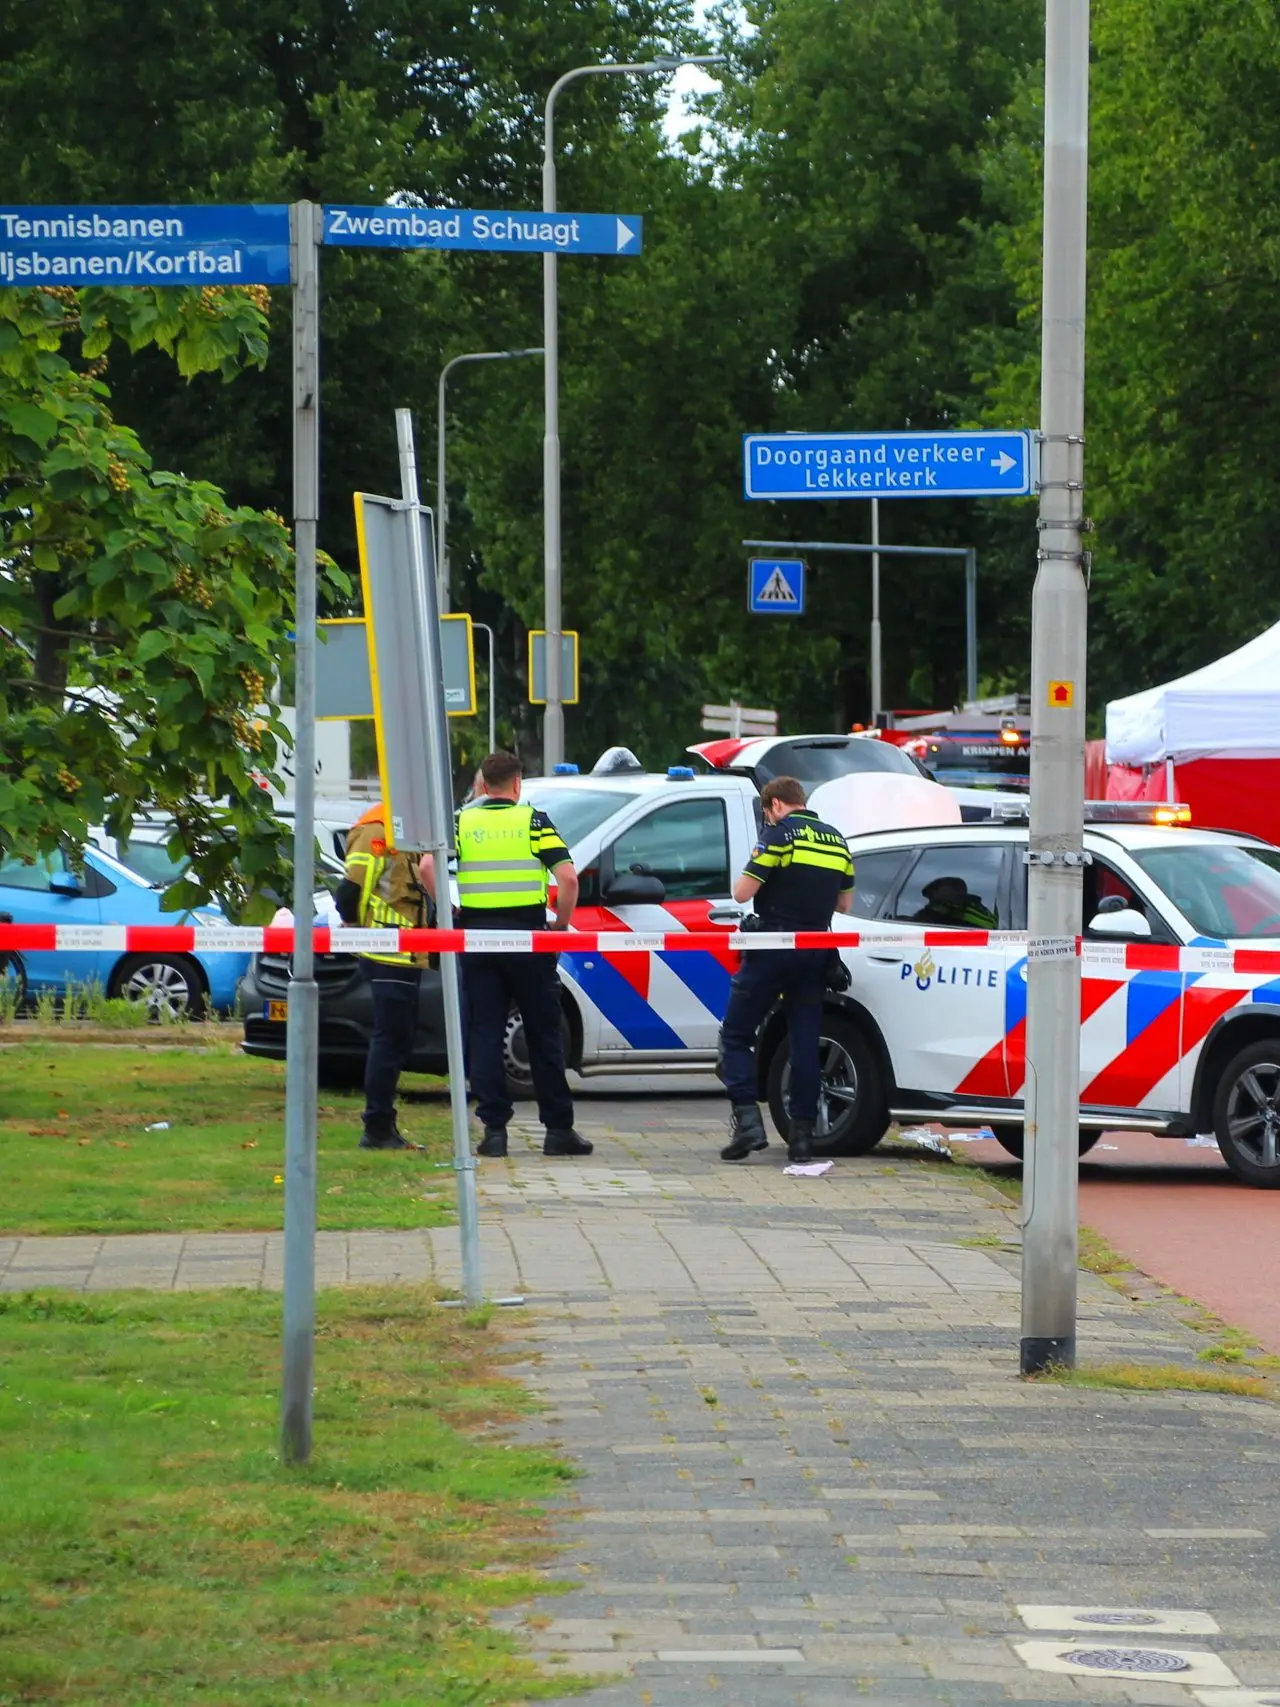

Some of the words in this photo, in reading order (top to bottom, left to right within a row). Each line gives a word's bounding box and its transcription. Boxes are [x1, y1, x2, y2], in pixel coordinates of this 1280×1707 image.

[1, 213, 184, 238] Tennisbanen
[328, 210, 460, 239] Zwembad
[472, 215, 580, 246] Schuagt
[756, 444, 886, 470] Doorgaand
[893, 443, 985, 464] verkeer
[805, 467, 938, 488] Lekkerkerk
[962, 745, 1015, 756] KRIMPEN
[464, 829, 525, 843] POLITIE
[901, 961, 998, 991] POLITIE
